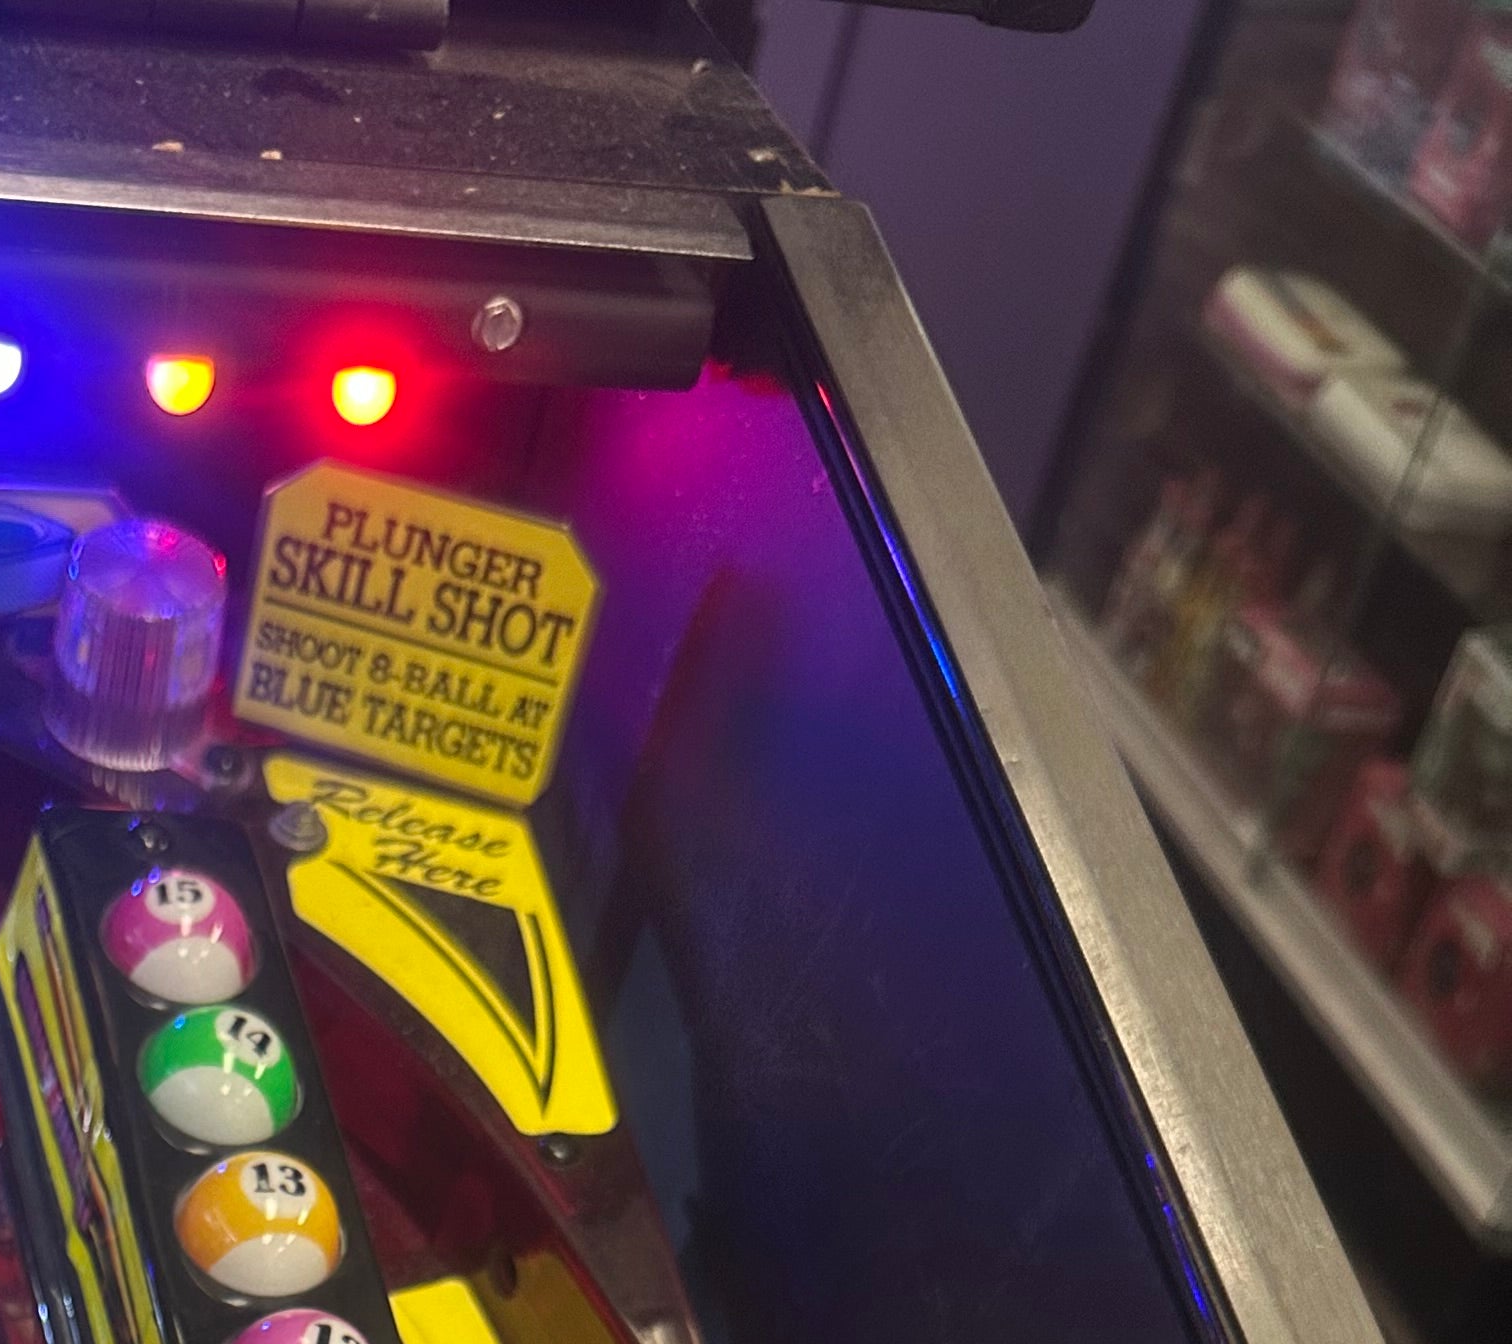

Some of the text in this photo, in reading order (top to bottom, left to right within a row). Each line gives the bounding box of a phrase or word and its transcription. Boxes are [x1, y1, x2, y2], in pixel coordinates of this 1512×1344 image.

[325, 503, 541, 600] PLUNGER
[269, 535, 575, 668] SKILL SHOT
[255, 621, 361, 674] SHOOT
[368, 652, 500, 718] 8-BALL
[248, 662, 539, 780] BLUE TARGETS
[308, 780, 510, 858] Release
[153, 880, 202, 907] 15
[373, 838, 502, 899] Here
[228, 1016, 271, 1056] 14
[251, 1164, 306, 1196] 13
